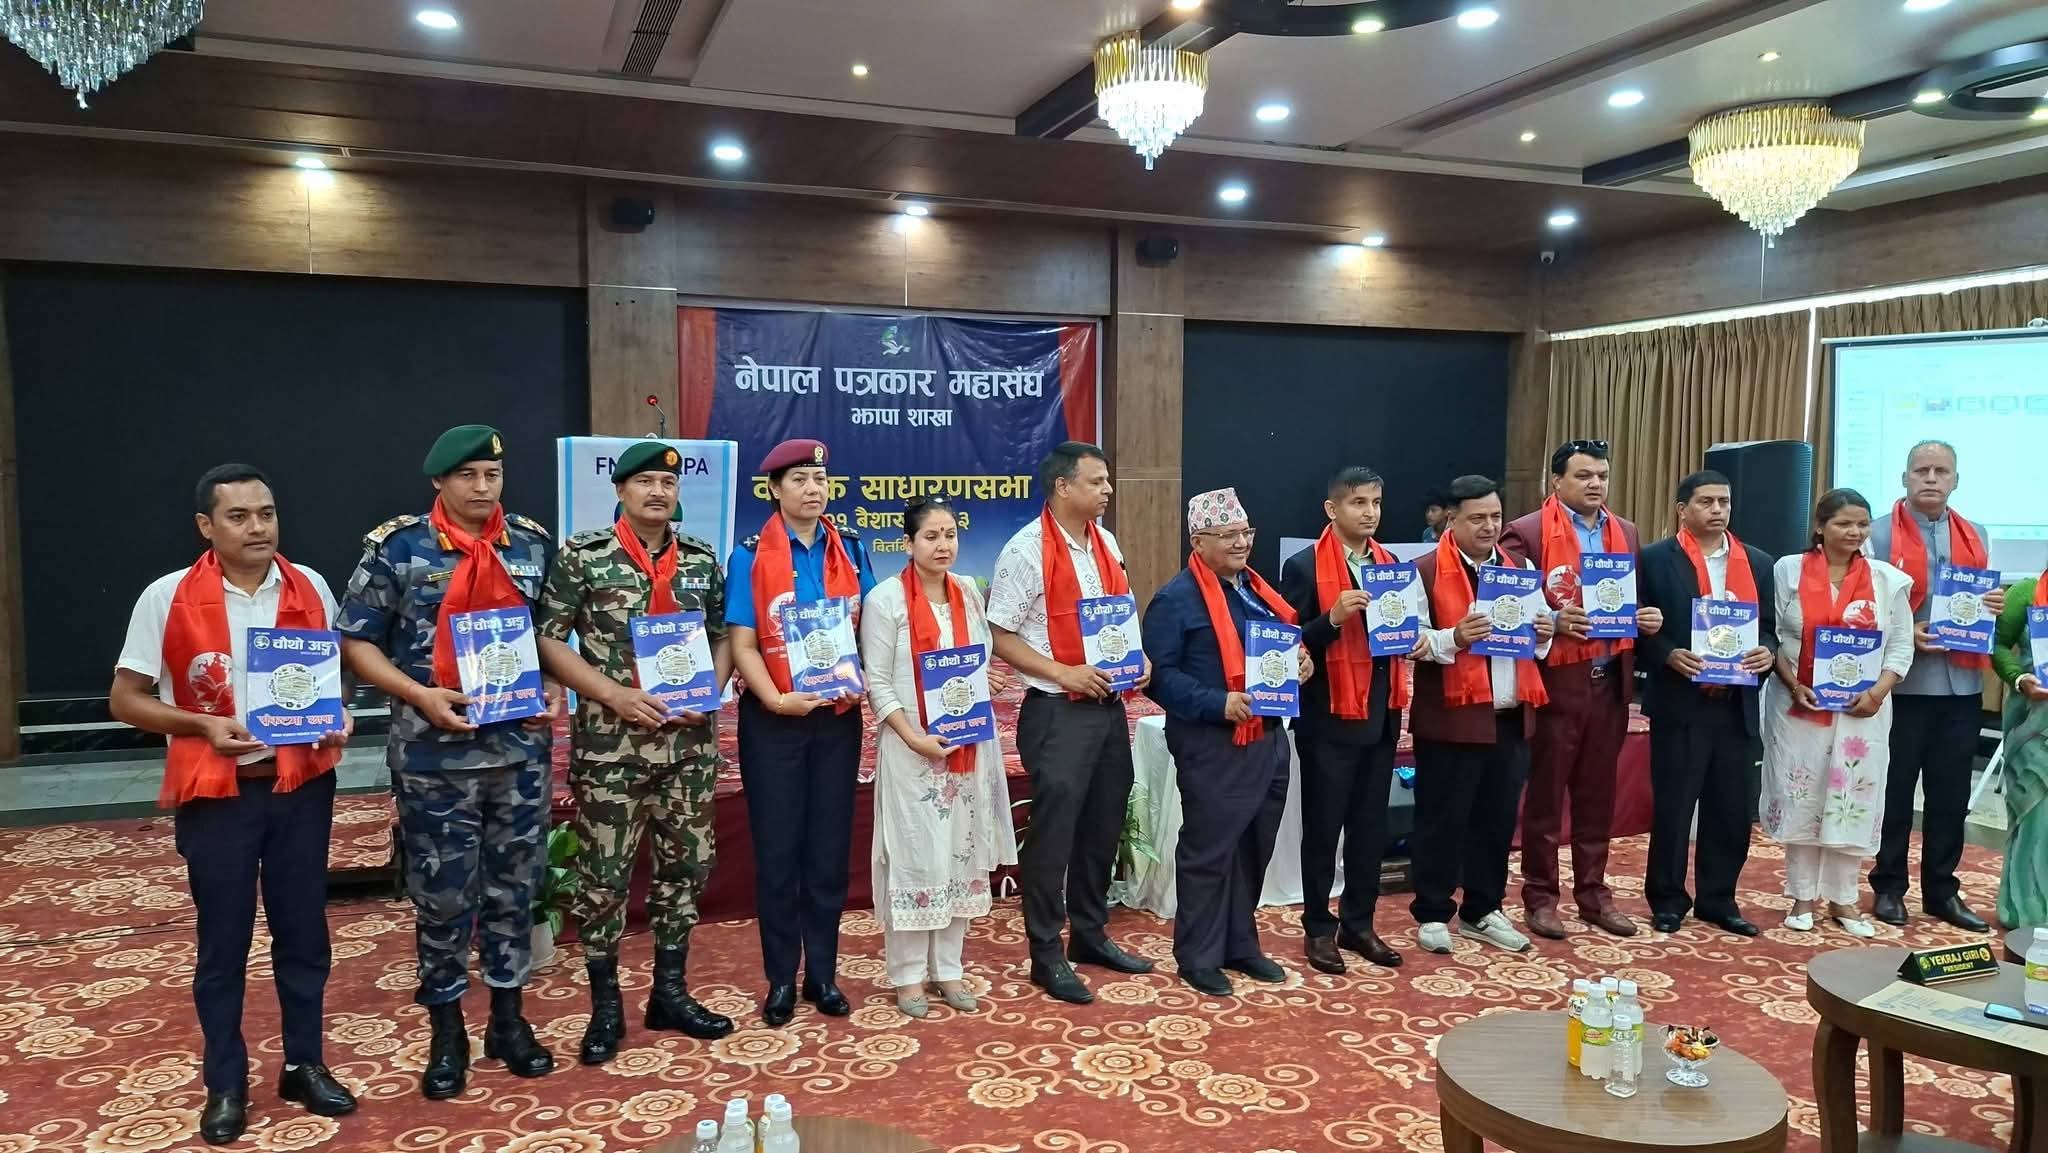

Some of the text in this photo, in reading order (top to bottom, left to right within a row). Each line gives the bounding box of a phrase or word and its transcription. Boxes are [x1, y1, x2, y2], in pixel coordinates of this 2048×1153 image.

[735, 355, 1045, 400] नेपाल पत्रकार महासंघ
[851, 407, 952, 427] झापा शाखा
[860, 475, 1033, 501] साधारणसभा
[272, 636, 304, 652] चौथो
[1929, 949, 1981, 966] YEKRAJ GIRI
[1942, 962, 1975, 973] PRESIDENT
